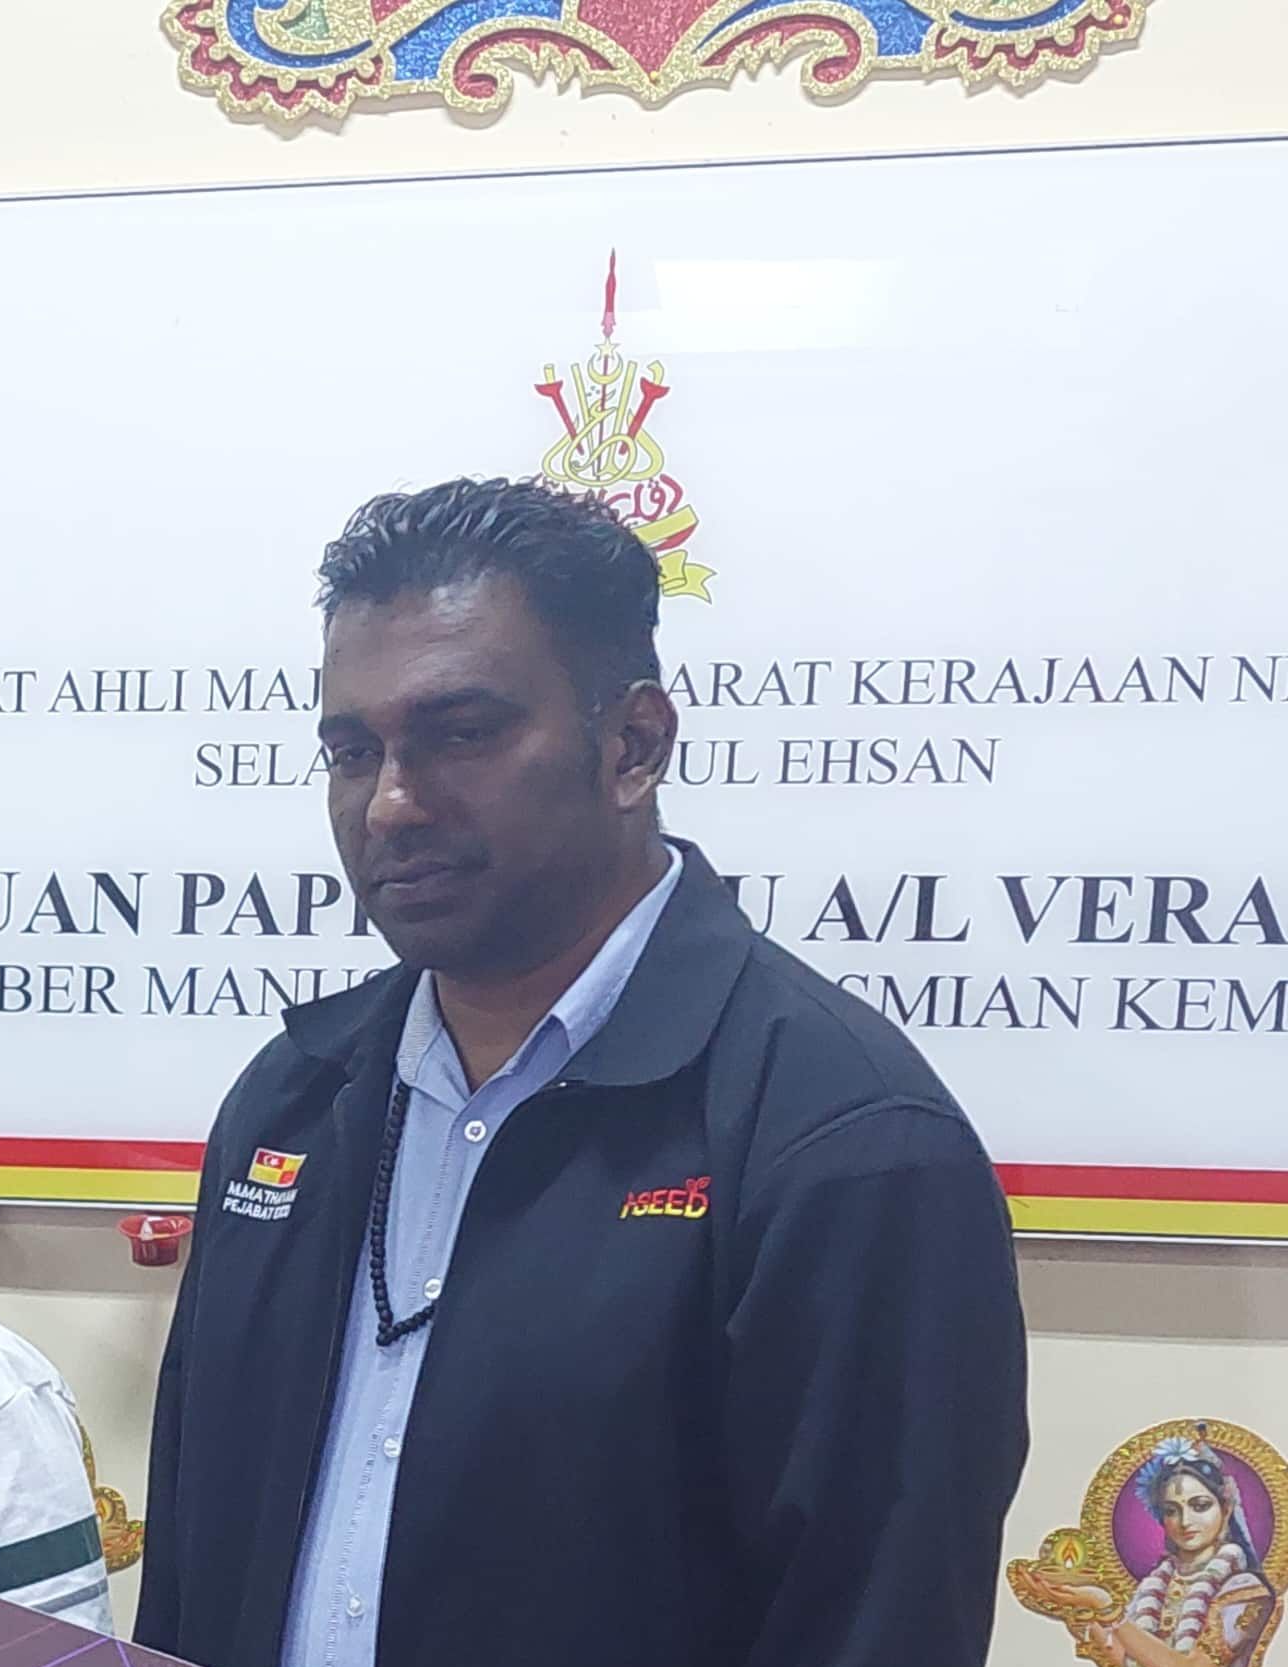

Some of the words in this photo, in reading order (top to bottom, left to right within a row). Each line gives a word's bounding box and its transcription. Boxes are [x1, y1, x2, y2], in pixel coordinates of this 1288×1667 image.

[51, 670, 190, 712] AHLI
[206, 668, 321, 711] MAJ
[666, 661, 831, 706] ARAT
[848, 656, 1214, 706] KERAJAAN
[195, 743, 332, 786] SELA
[664, 740, 759, 785] UL
[775, 737, 1001, 785] EHSAN
[174, 872, 376, 936] PAP
[800, 874, 971, 943] A/L
[996, 874, 1288, 946] VERA
[144, 967, 382, 1017] MANU
[836, 974, 1089, 1030] MIAN
[1106, 976, 1288, 1032] KEM
